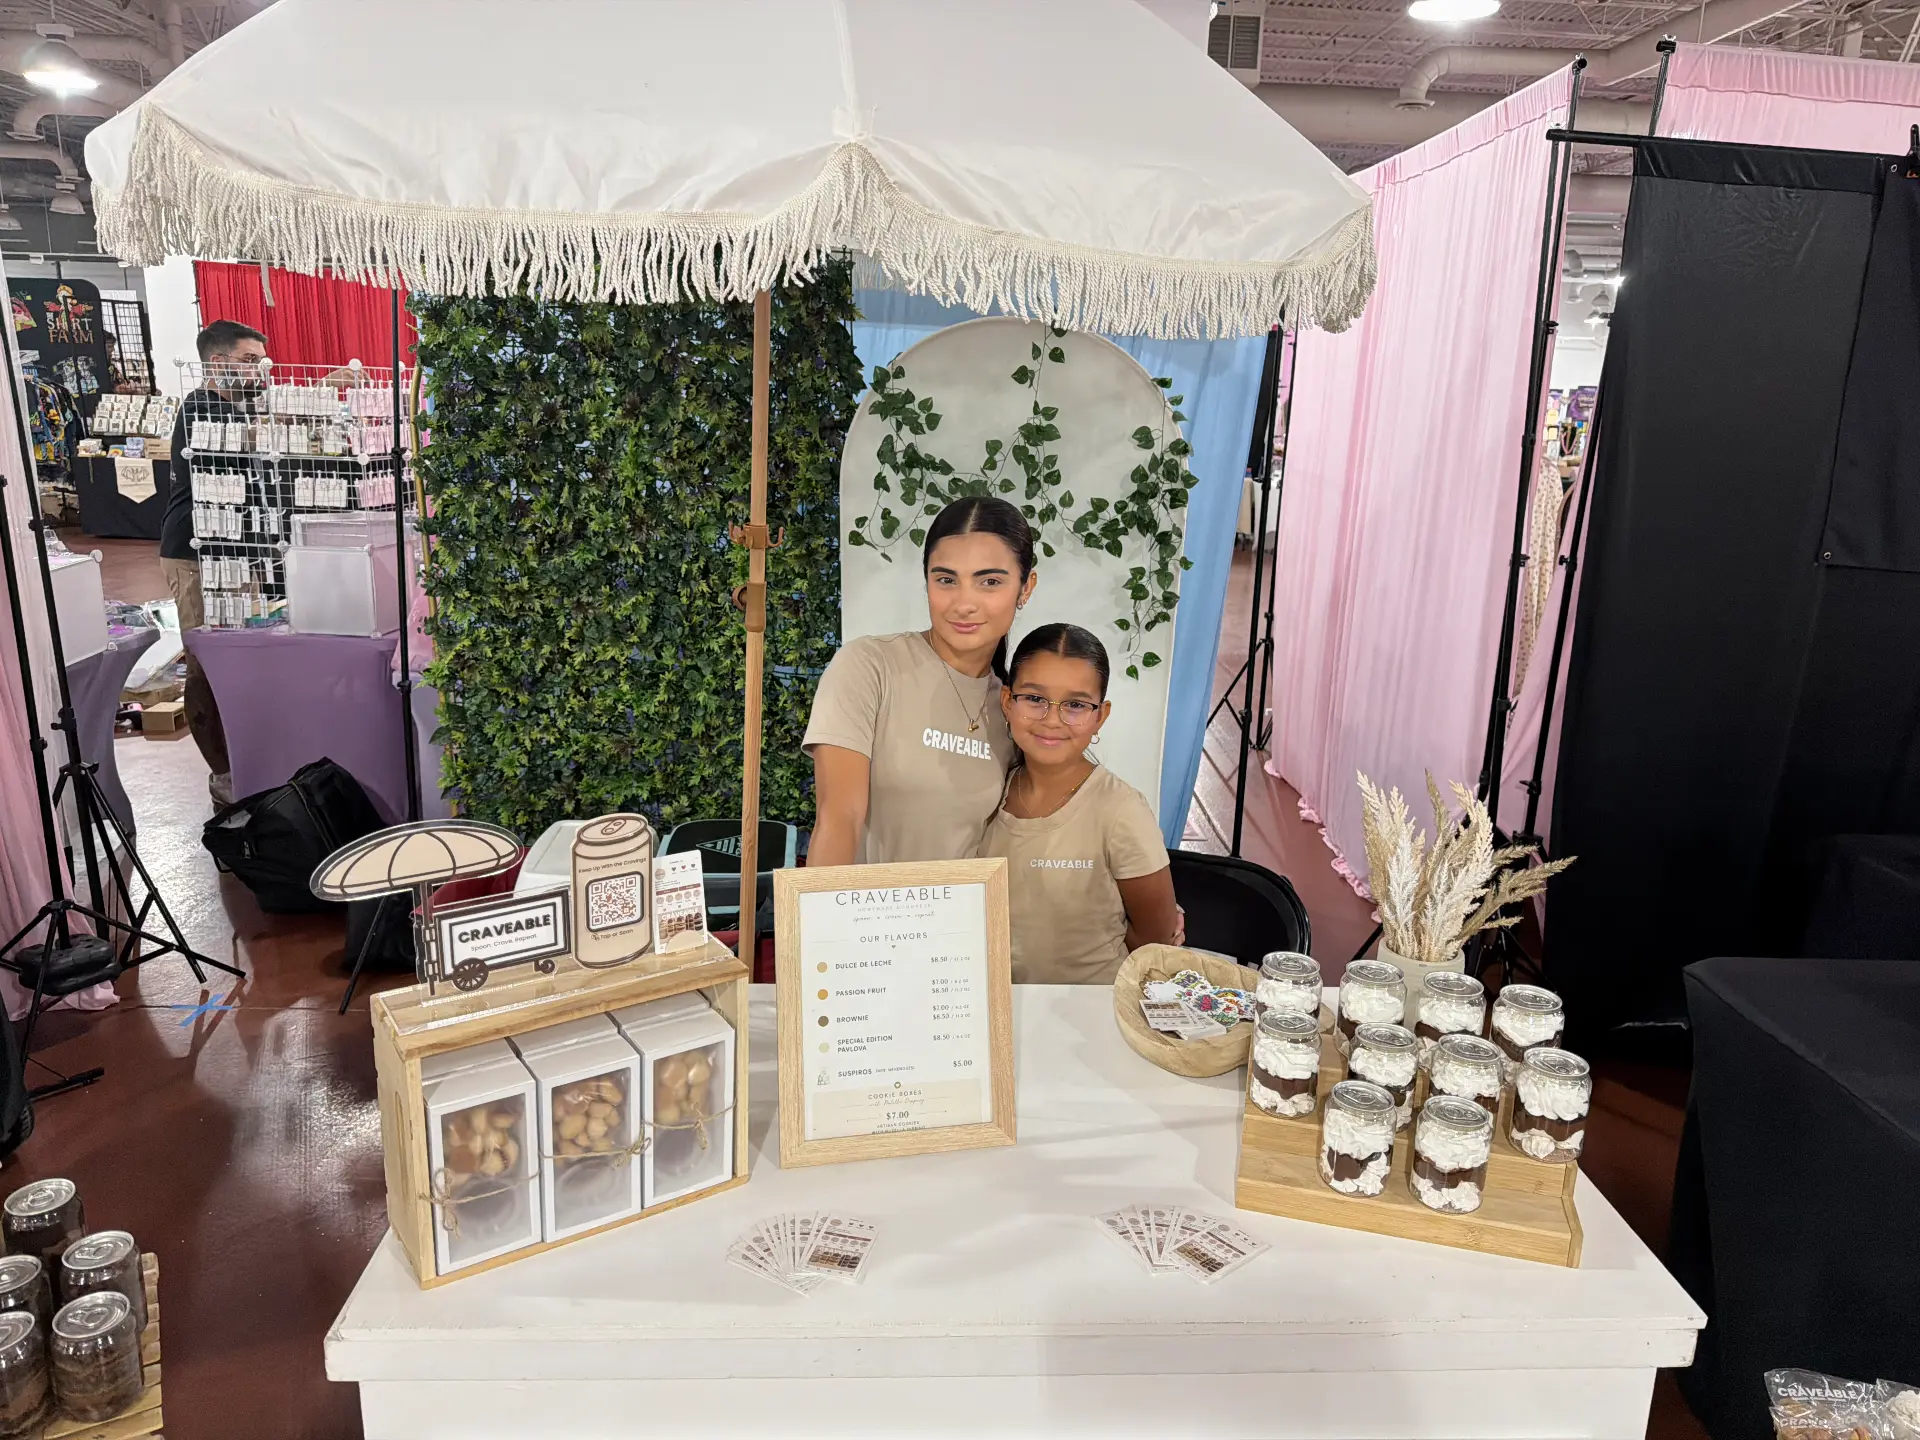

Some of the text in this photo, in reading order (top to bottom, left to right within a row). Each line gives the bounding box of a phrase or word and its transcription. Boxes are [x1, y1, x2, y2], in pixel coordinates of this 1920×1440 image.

[46, 317, 92, 331] SHRT
[922, 727, 992, 760] CRAVEABLE
[623, 857, 647, 866] Cravings
[1030, 859, 1094, 869] CRAVEABLE
[835, 886, 952, 906] CRAVEABLE
[457, 914, 551, 943] CRAVEABLE
[859, 931, 928, 943] OUR FLAVORS
[835, 962, 857, 970] DULCE
[836, 1014, 869, 1023] BROWNIE
[837, 1035, 893, 1046] SPECIAL EDITION
[837, 1045, 867, 1053] PAVLOVA
[952, 1059, 973, 1068] $5.00
[837, 1069, 872, 1077] SUSPIROS
[868, 1089, 922, 1099] COOKIE BOXES
[886, 1110, 910, 1120] $7.00
[1777, 1387, 1858, 1400] CRAVEABLE
